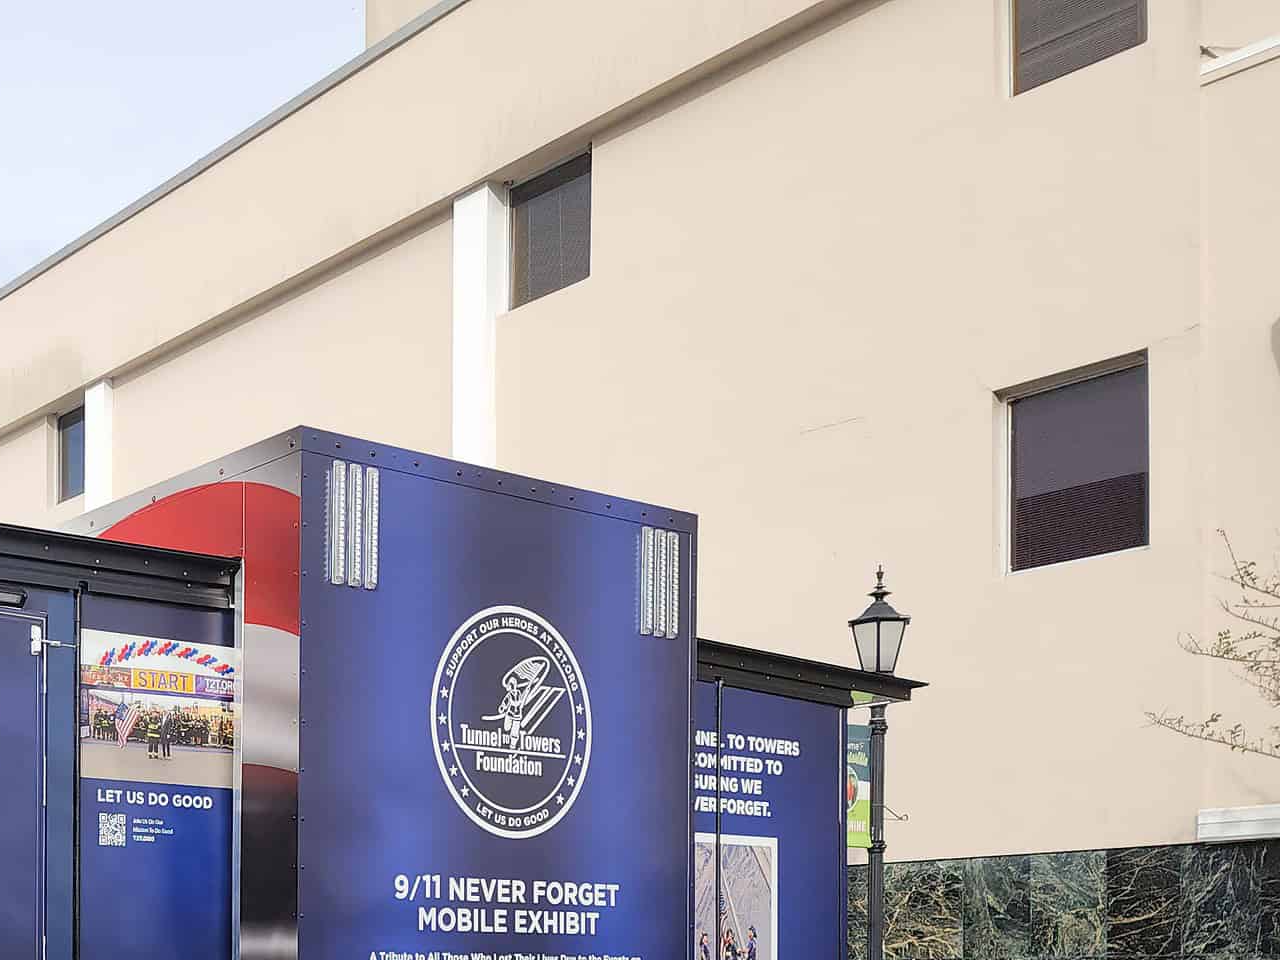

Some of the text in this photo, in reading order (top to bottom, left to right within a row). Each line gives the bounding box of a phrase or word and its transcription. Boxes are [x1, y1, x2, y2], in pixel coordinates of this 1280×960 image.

[446, 617, 579, 692] SUPPORT OUR HEROES AT T2T.ORG
[139, 671, 189, 691] START
[460, 724, 502, 747] Tunnel
[519, 730, 561, 753] Towers
[727, 734, 745, 750] TO
[747, 736, 800, 756] TOWERS
[476, 751, 542, 777] Foundation
[695, 752, 783, 775] OMMITTED TO
[695, 773, 762, 795] URNG WE
[97, 788, 213, 809] LET US DO GOOD
[720, 797, 771, 817] FORGET.
[476, 803, 549, 827] LET US DO GOOD
[394, 874, 619, 907] 9/11 NEVER FORGET
[418, 906, 600, 935] MOBILE EXHIBIT
